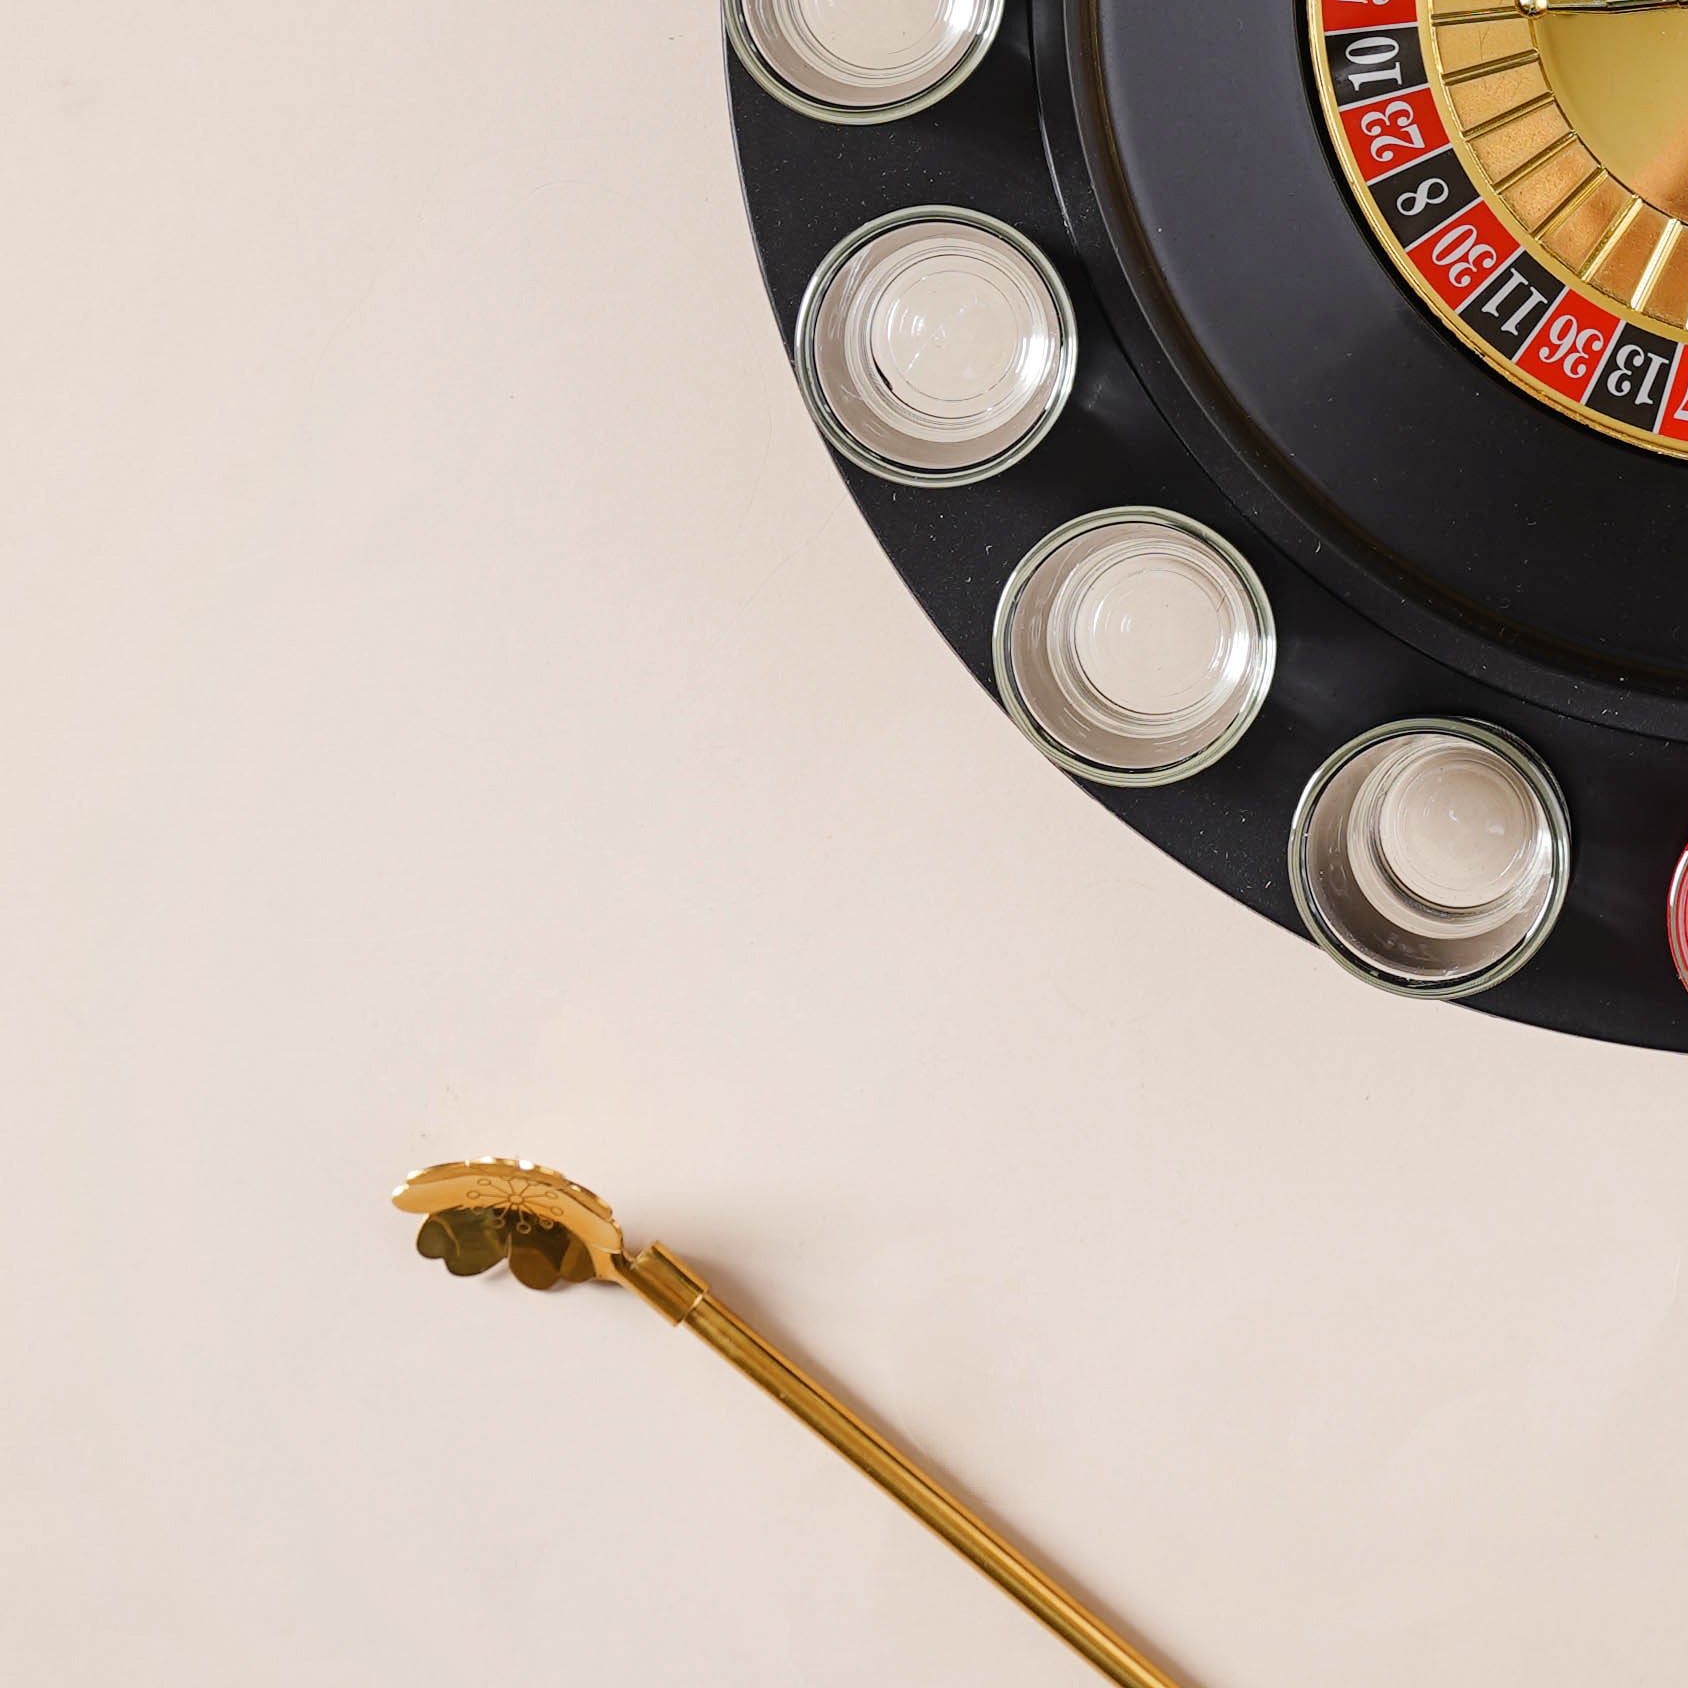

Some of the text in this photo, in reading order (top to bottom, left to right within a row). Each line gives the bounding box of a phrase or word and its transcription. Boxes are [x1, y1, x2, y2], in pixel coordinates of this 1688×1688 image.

[1345, 36, 1402, 91] 10
[1360, 100, 1425, 162] 23
[1396, 177, 1449, 216] 8
[1431, 224, 1497, 288] 30
[1481, 267, 1548, 336] 11
[1539, 314, 1604, 379] 36
[1606, 344, 1670, 405] 13
